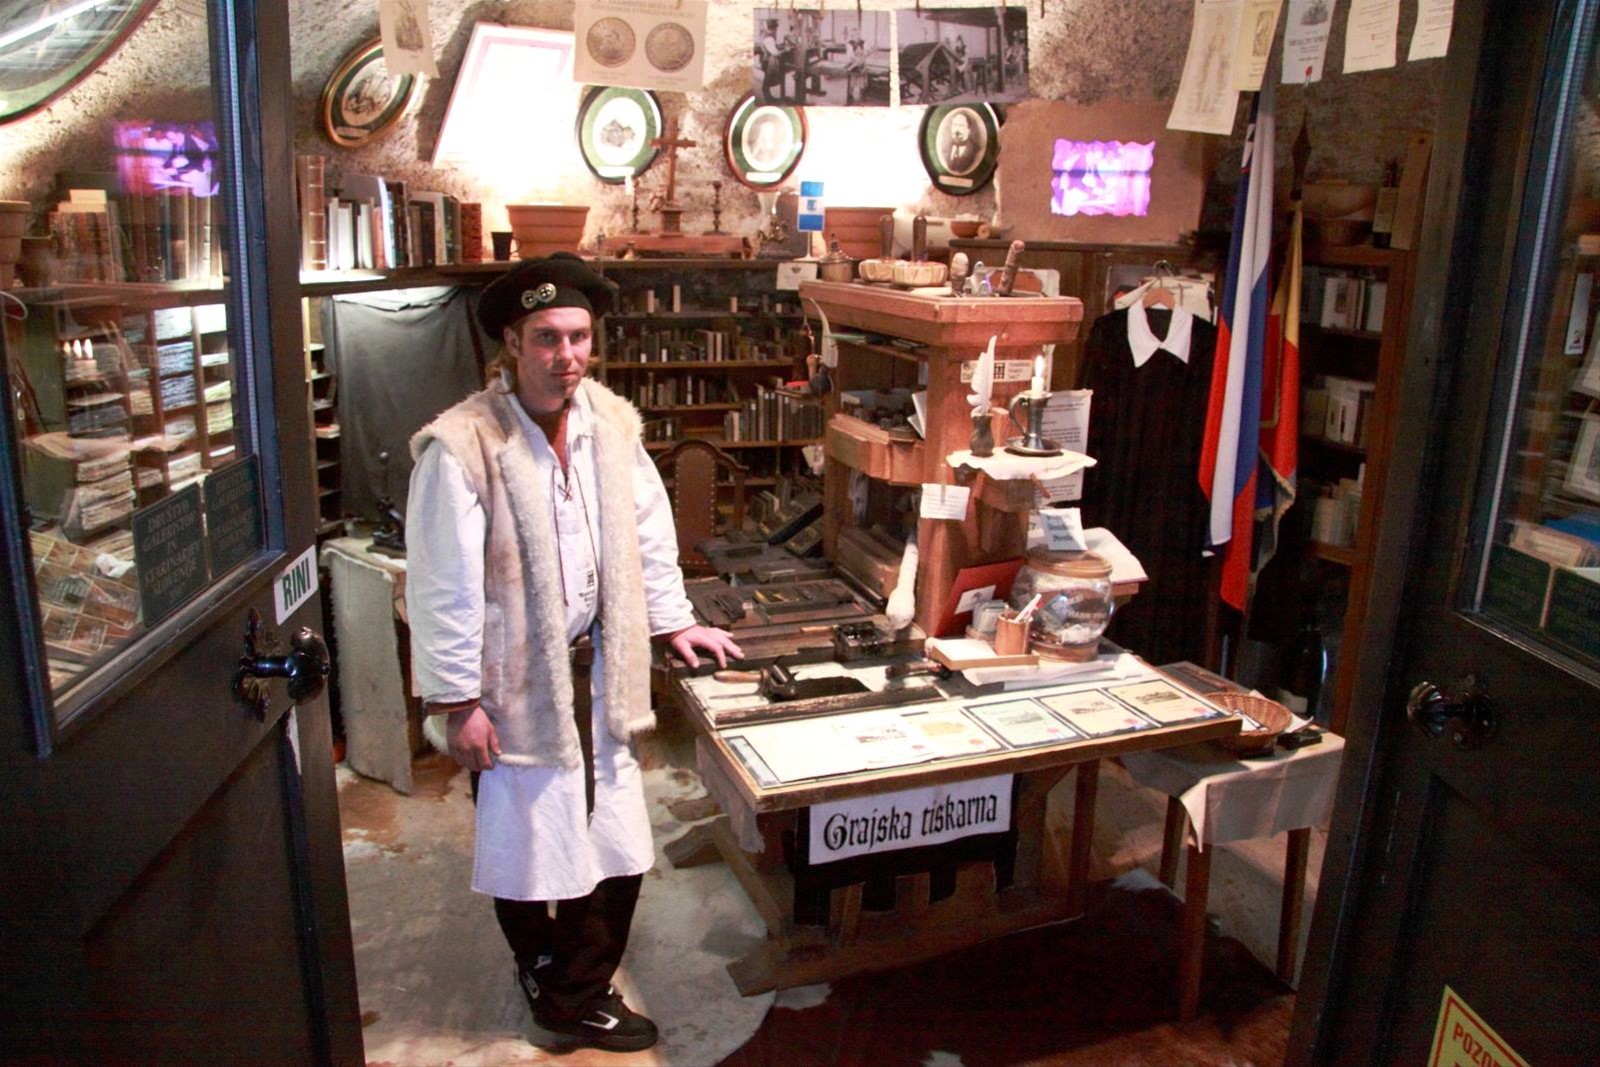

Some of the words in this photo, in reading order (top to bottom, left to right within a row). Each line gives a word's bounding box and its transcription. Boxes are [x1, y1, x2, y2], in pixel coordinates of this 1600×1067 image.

[282, 557, 311, 611] RINI
[824, 806, 912, 851] Grajska
[921, 794, 998, 836] tiskarna
